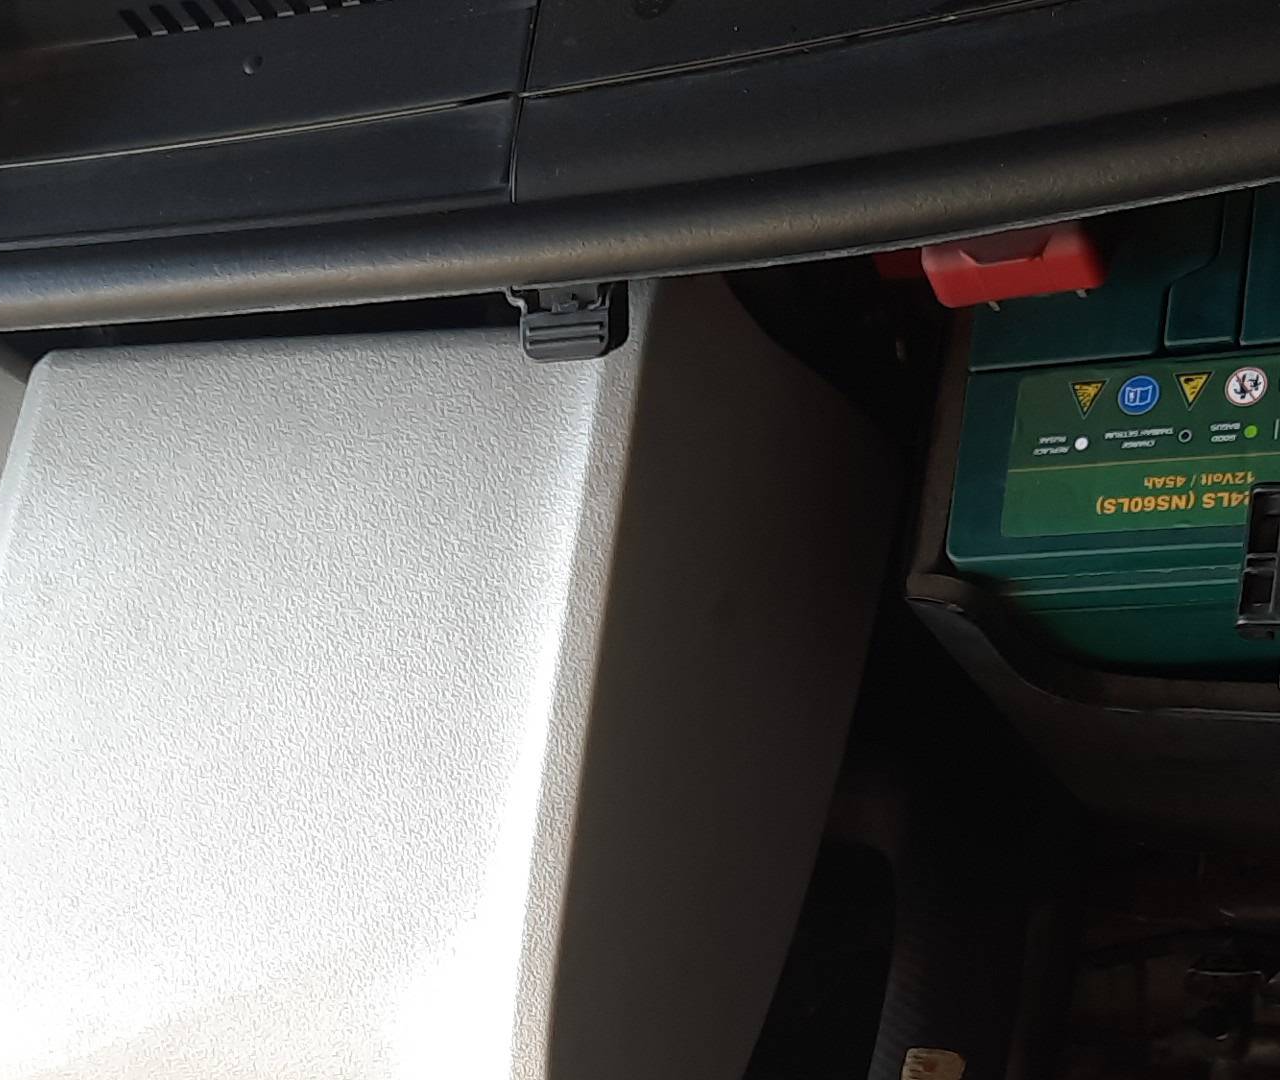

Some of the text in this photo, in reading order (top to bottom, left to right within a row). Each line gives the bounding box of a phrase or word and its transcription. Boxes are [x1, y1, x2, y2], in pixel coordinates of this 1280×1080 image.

[1143, 474, 1186, 490] 45Ah
[1201, 471, 1256, 487] 12Volt
[1096, 491, 1195, 515] (NS60LS)
